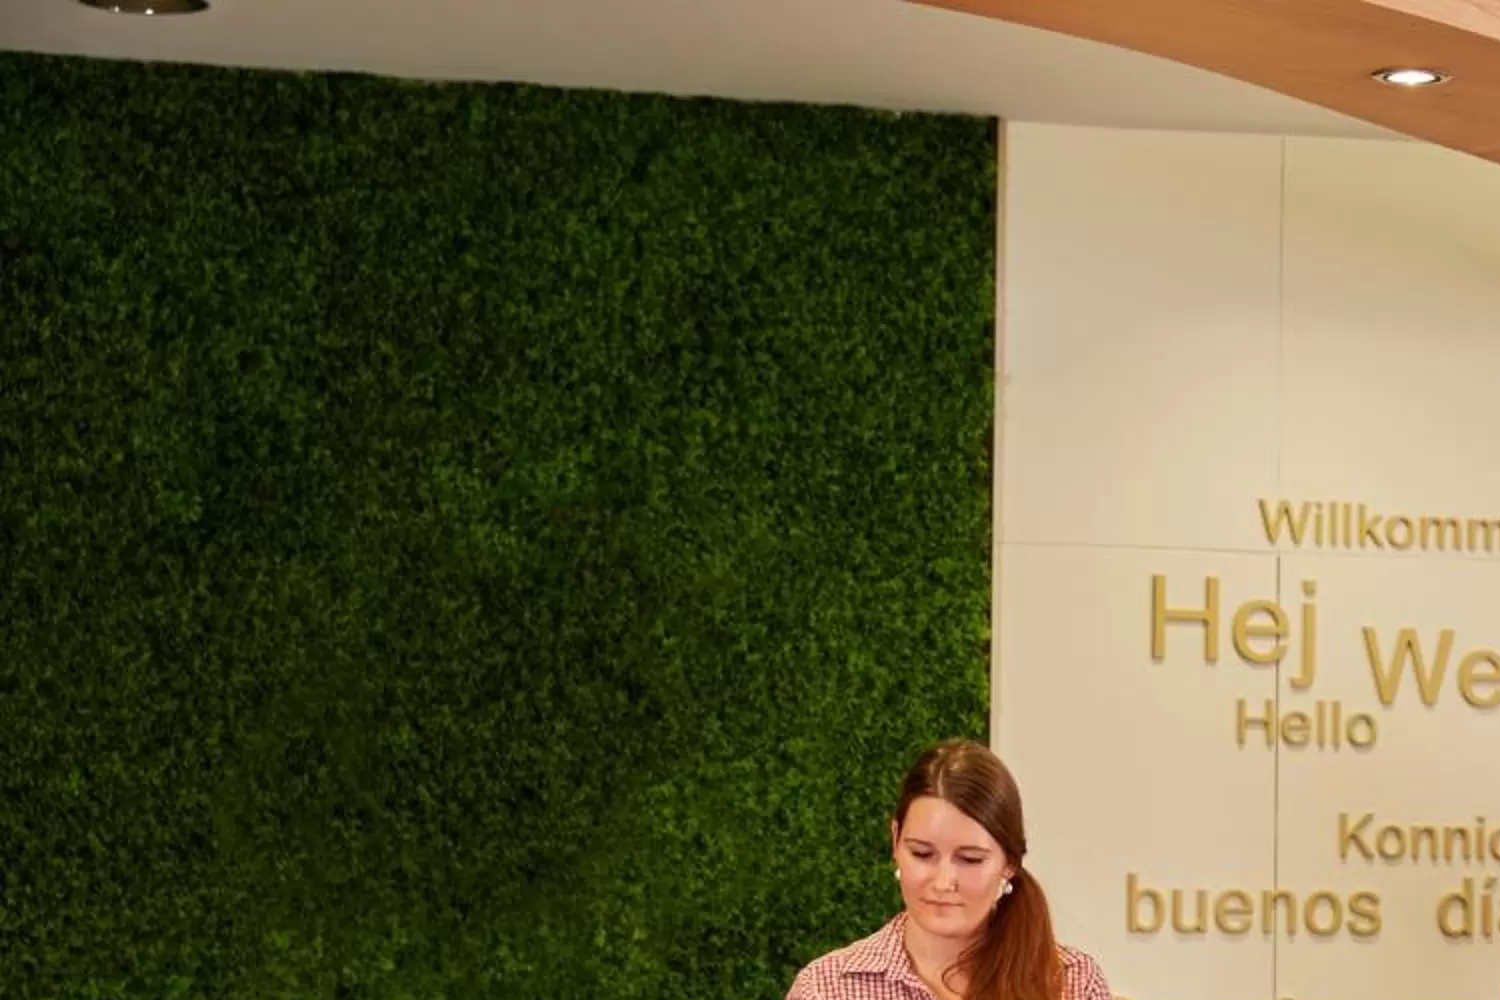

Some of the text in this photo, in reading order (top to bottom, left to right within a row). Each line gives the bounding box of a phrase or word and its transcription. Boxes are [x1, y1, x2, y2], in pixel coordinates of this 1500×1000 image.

[1151, 574, 1318, 690] Hej
[1235, 698, 1378, 750] Hello
[1125, 873, 1382, 938] buenos
